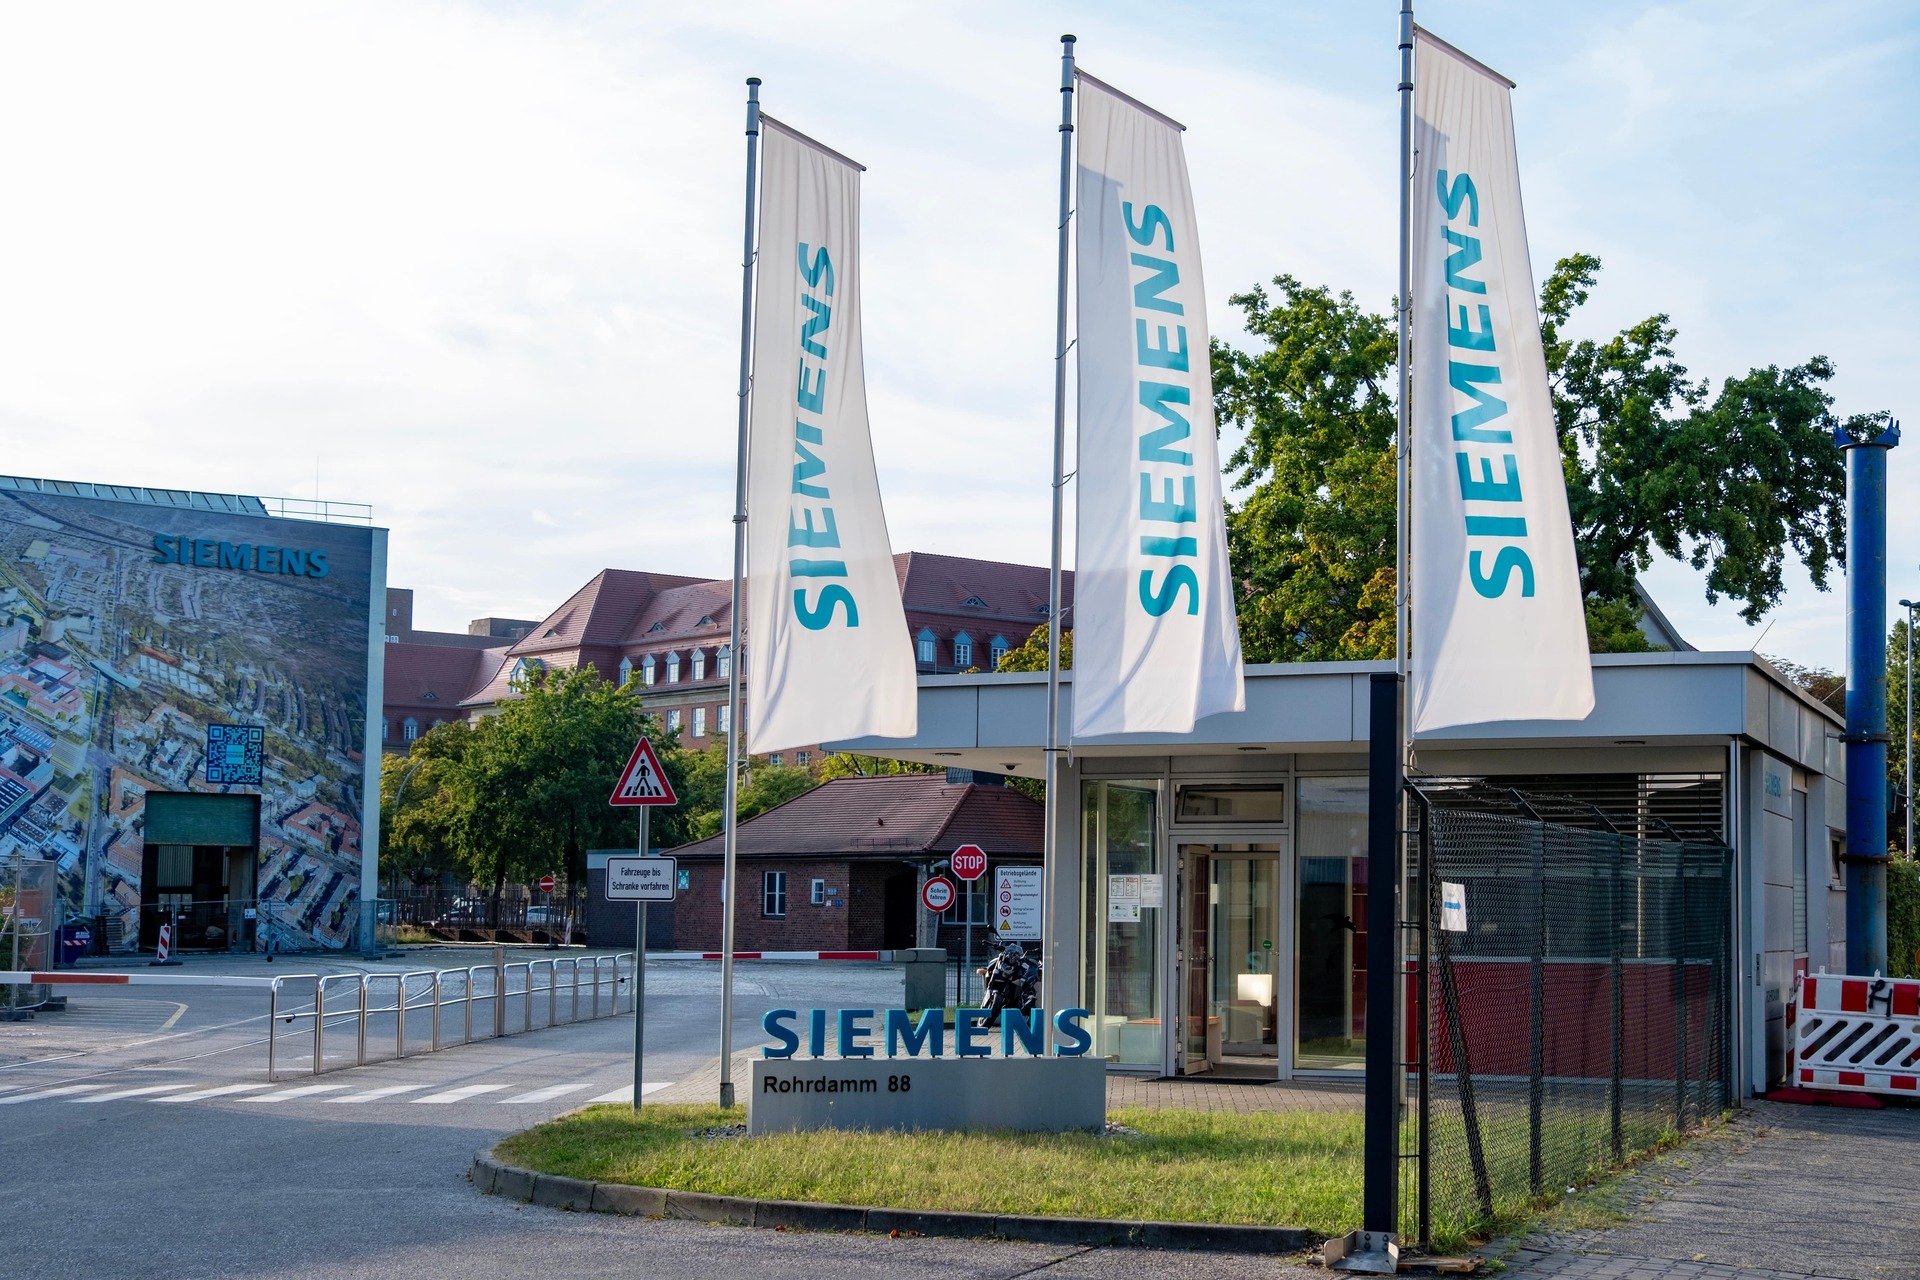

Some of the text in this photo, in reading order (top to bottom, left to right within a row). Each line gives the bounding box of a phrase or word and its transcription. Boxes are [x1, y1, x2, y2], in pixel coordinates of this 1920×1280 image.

[1436, 169, 1535, 599] SIEMENS
[1122, 201, 1199, 618] SIEMENS
[787, 242, 860, 631] SIEMENS
[153, 533, 330, 579] SIEMENS
[620, 867, 661, 878] Fahrzeuge bis
[955, 855, 983, 870] STOP
[612, 881, 669, 891] Schranke vorfahren
[761, 1008, 1093, 1057] SIEMENS
[763, 1075, 912, 1094] Rohrdamm 88
